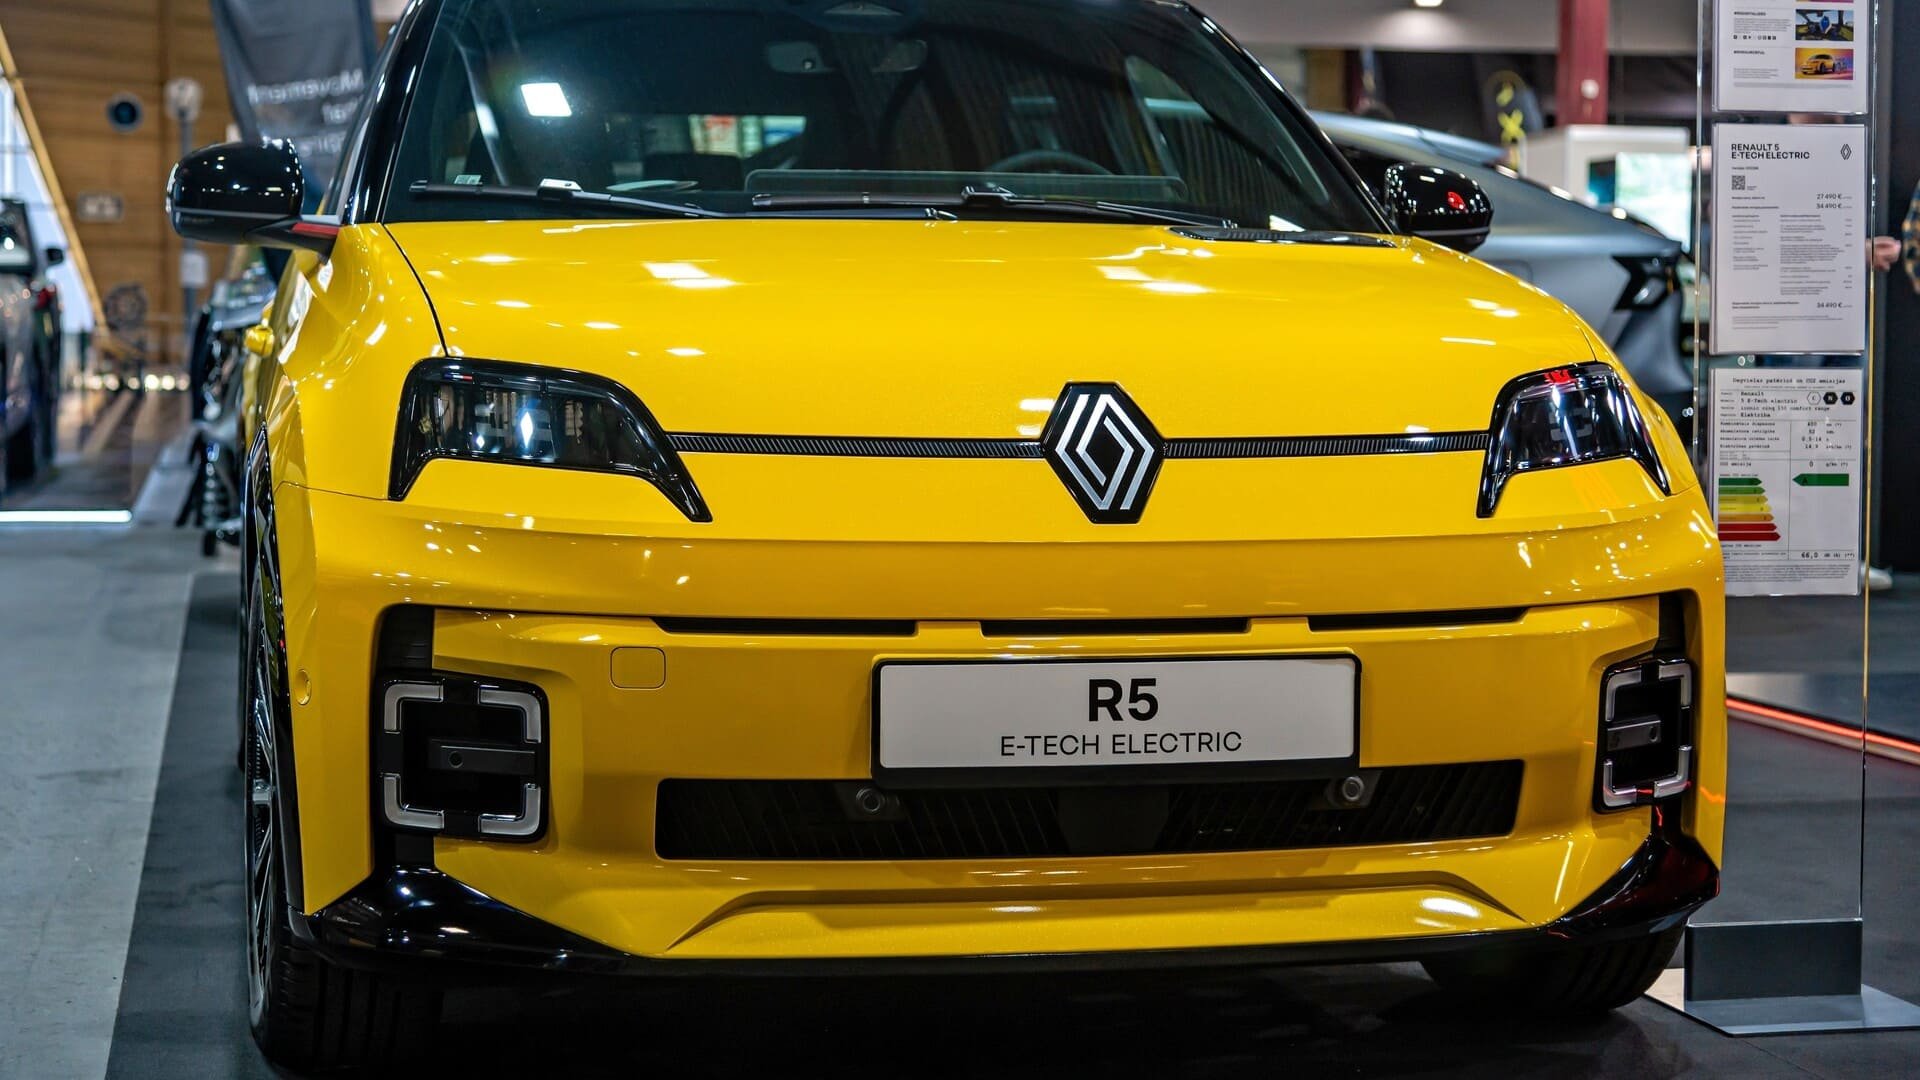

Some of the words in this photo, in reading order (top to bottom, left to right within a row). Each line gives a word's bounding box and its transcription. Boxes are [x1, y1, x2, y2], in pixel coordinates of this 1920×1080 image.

[1731, 143, 1773, 151] RENAULT
[1774, 143, 1780, 151] 5
[1731, 151, 1765, 159] E-TECH
[1765, 151, 1810, 159] ELECTRIC
[1089, 678, 1158, 721] R5
[1001, 735, 1099, 756] E-TECH
[1112, 731, 1242, 755] ELECTRIC
